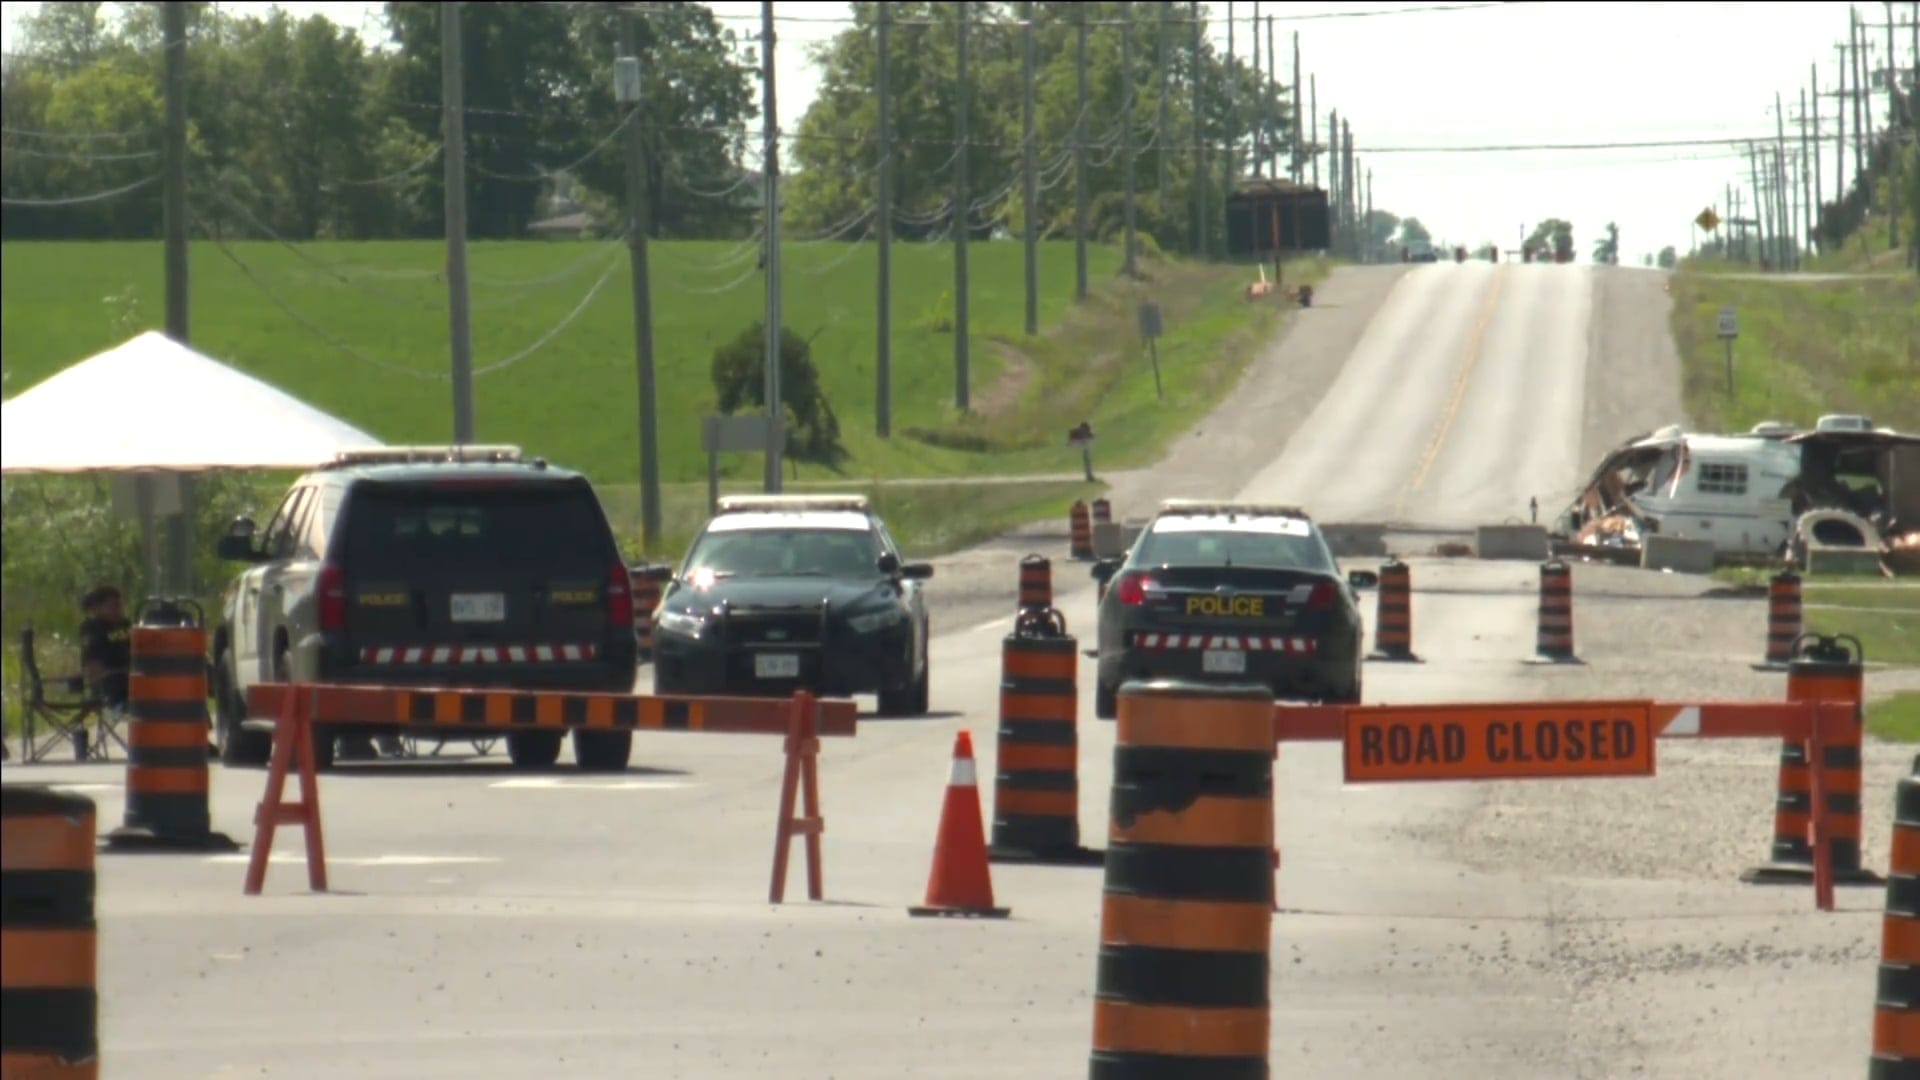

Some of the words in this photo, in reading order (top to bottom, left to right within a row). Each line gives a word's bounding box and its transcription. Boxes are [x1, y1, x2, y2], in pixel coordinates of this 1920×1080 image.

[359, 592, 406, 607] POLICE
[550, 590, 597, 604] POLICE
[1186, 597, 1264, 616] POLICE
[1360, 722, 1466, 767] ROAD
[1487, 718, 1636, 763] CLOSED
